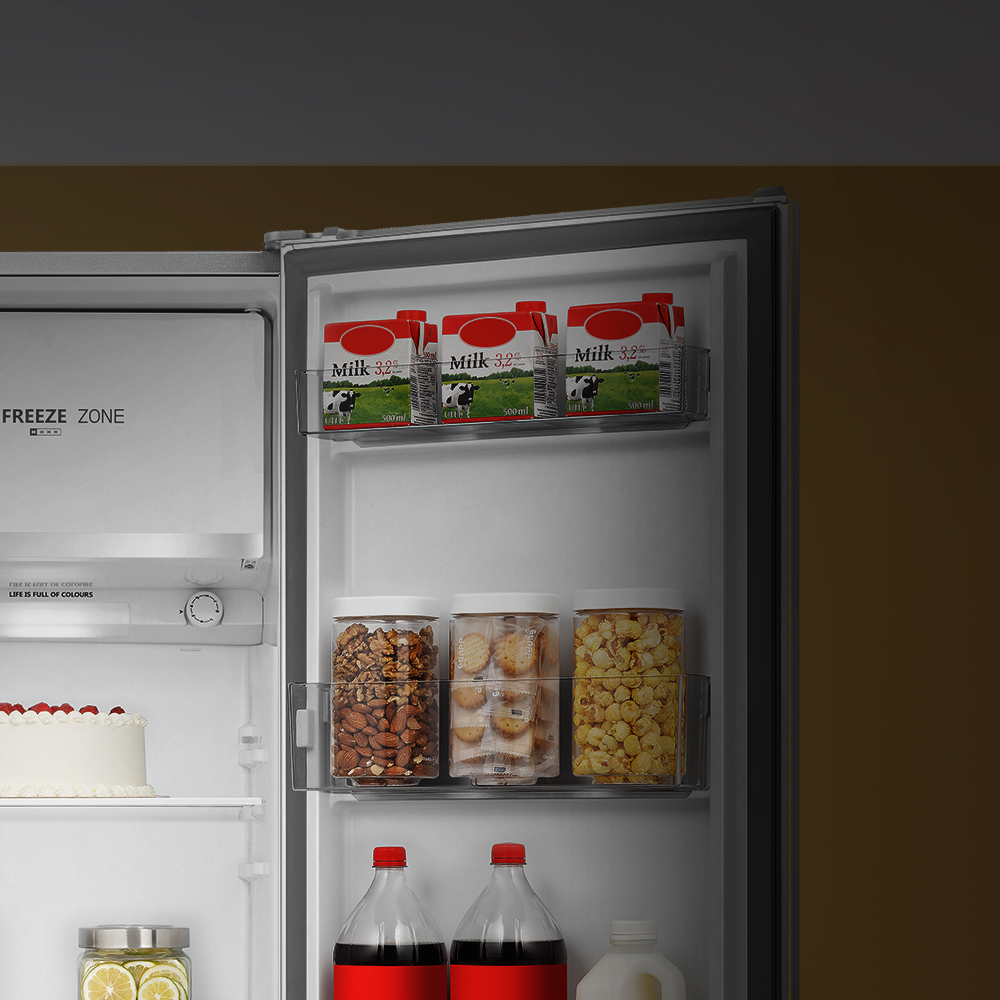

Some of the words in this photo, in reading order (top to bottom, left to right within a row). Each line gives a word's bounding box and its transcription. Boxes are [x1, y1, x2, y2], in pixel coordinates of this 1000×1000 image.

[449, 352, 489, 370] Milk
[574, 344, 614, 362] Milk
[331, 359, 370, 377] Milk
[2, 408, 67, 424] FREEZE
[77, 408, 125, 424] ZONE
